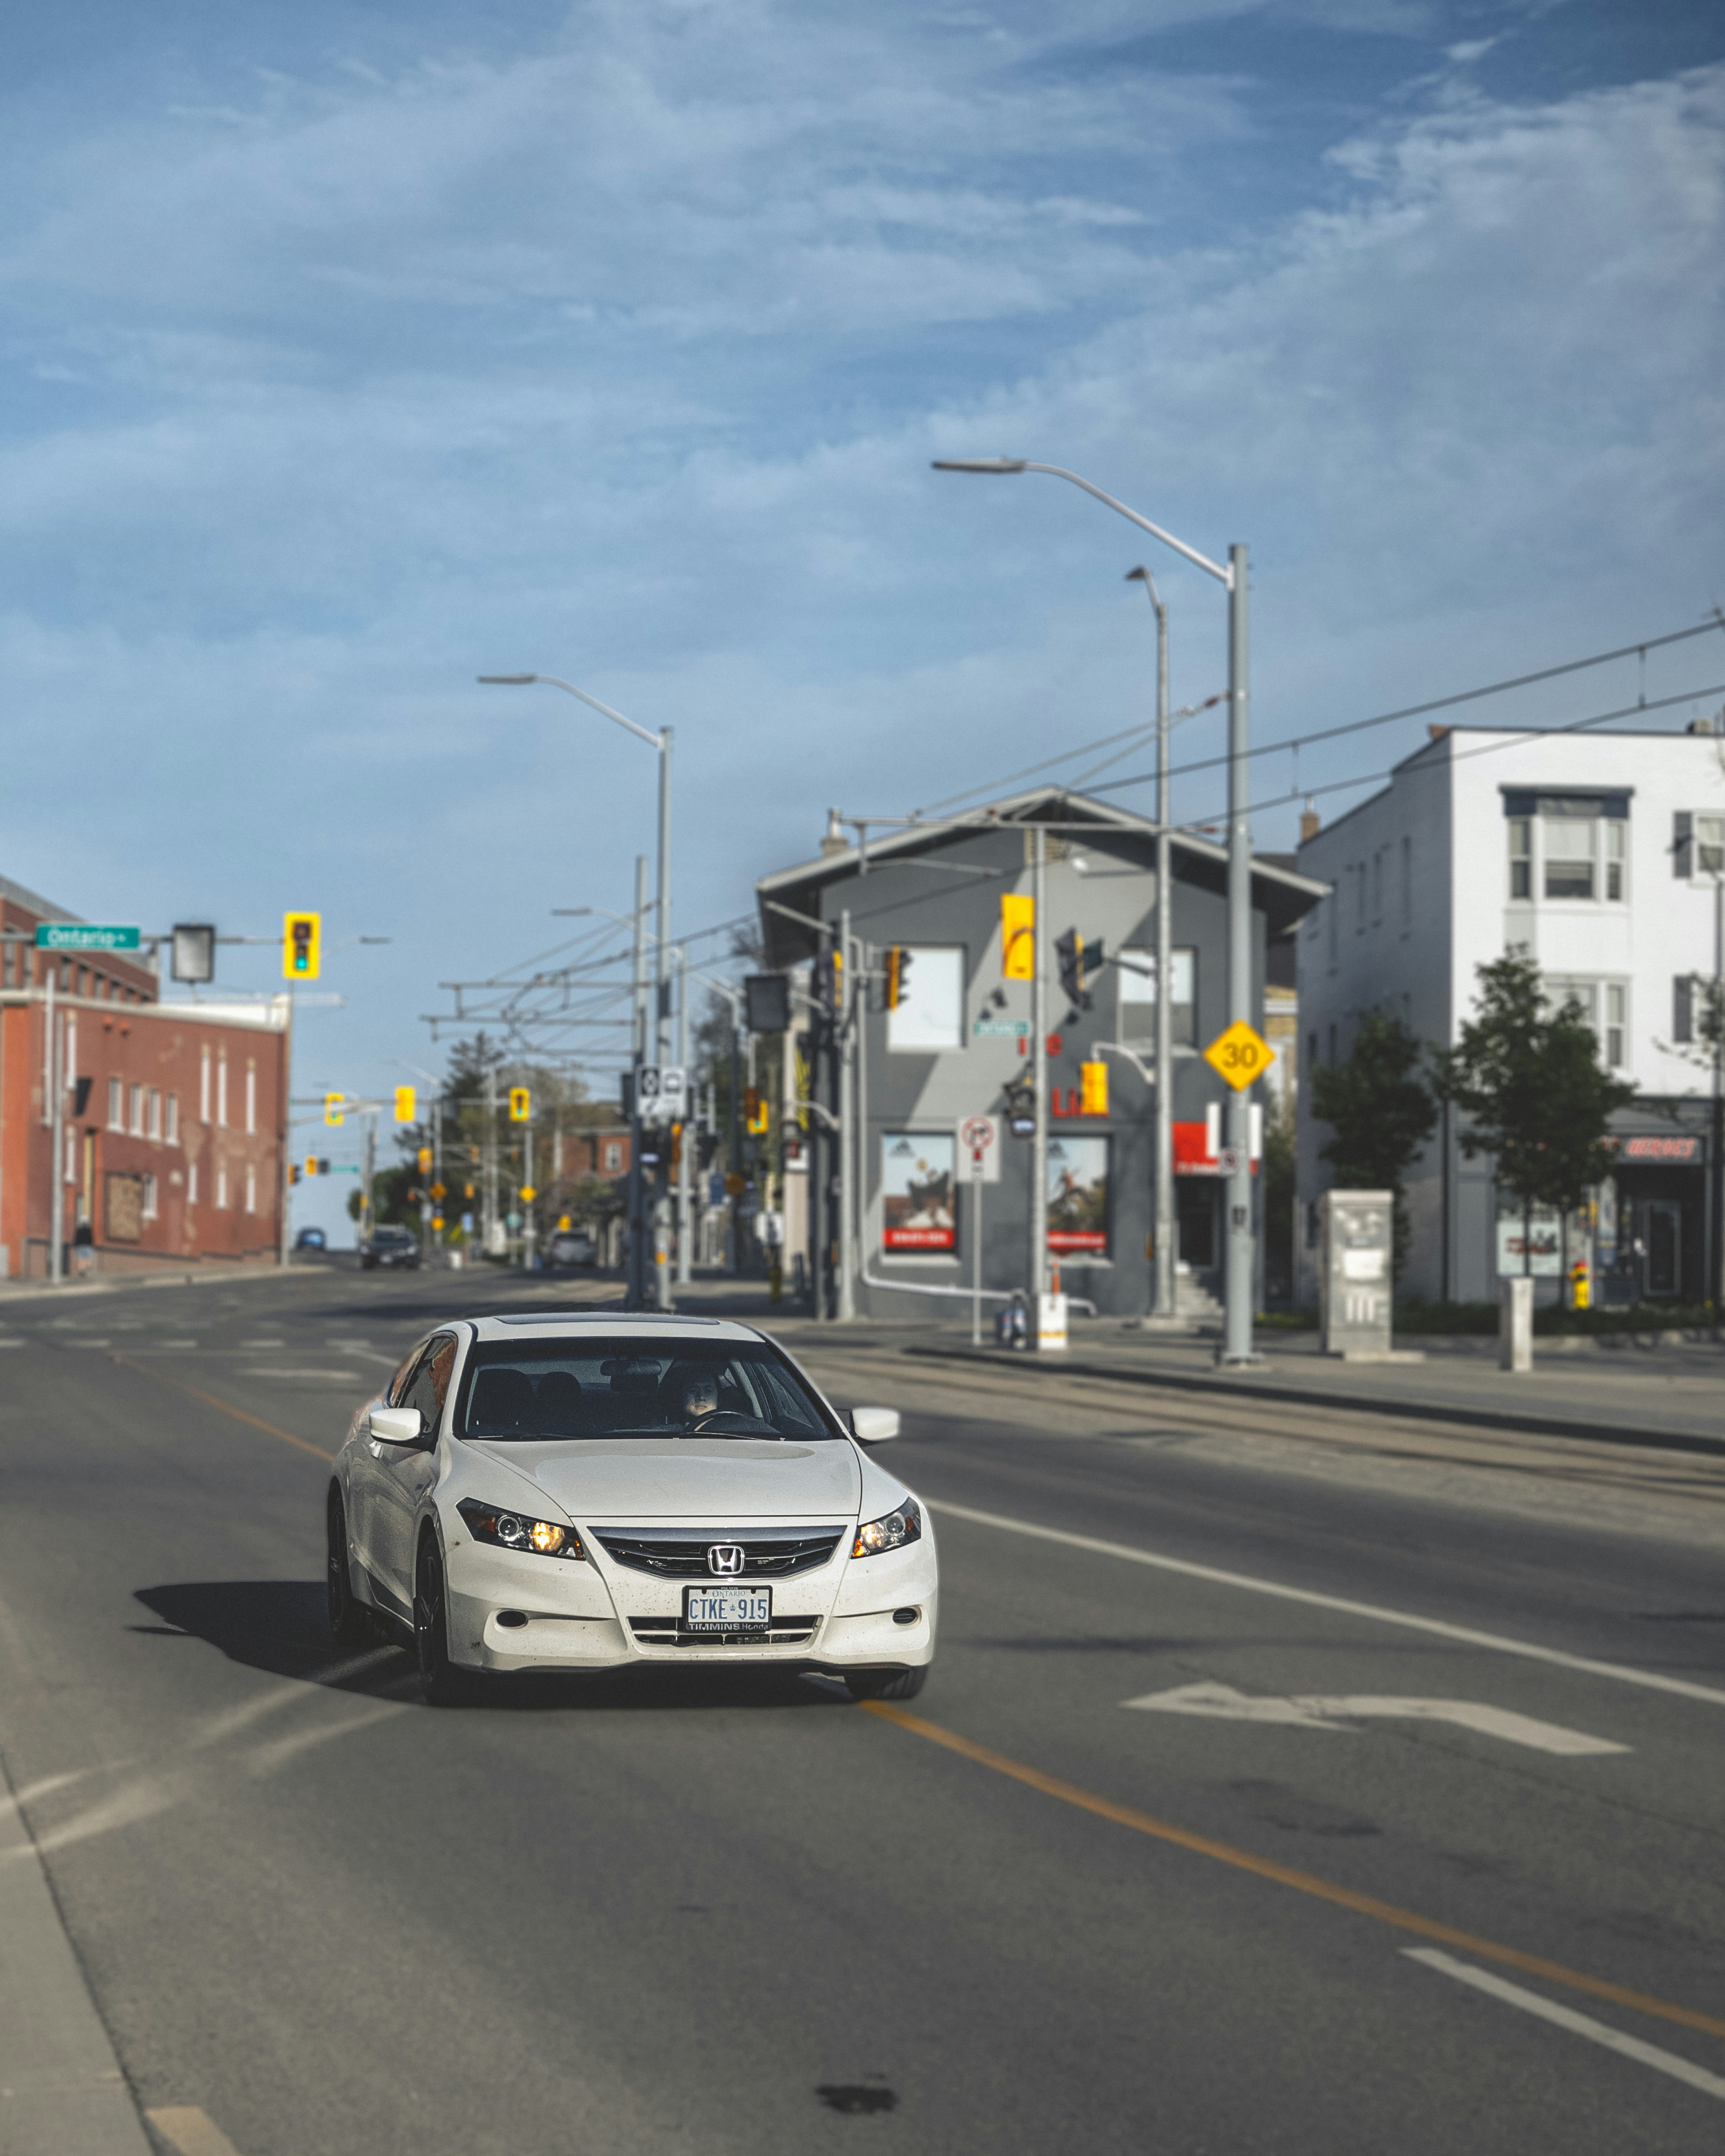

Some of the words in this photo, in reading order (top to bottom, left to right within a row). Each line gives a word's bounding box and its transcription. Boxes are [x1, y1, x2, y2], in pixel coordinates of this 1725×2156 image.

[47, 927, 116, 949] Ontario
[1222, 1041, 1259, 1070] 30
[690, 1598, 728, 1620] CTKE
[738, 1598, 767, 1620] 915
